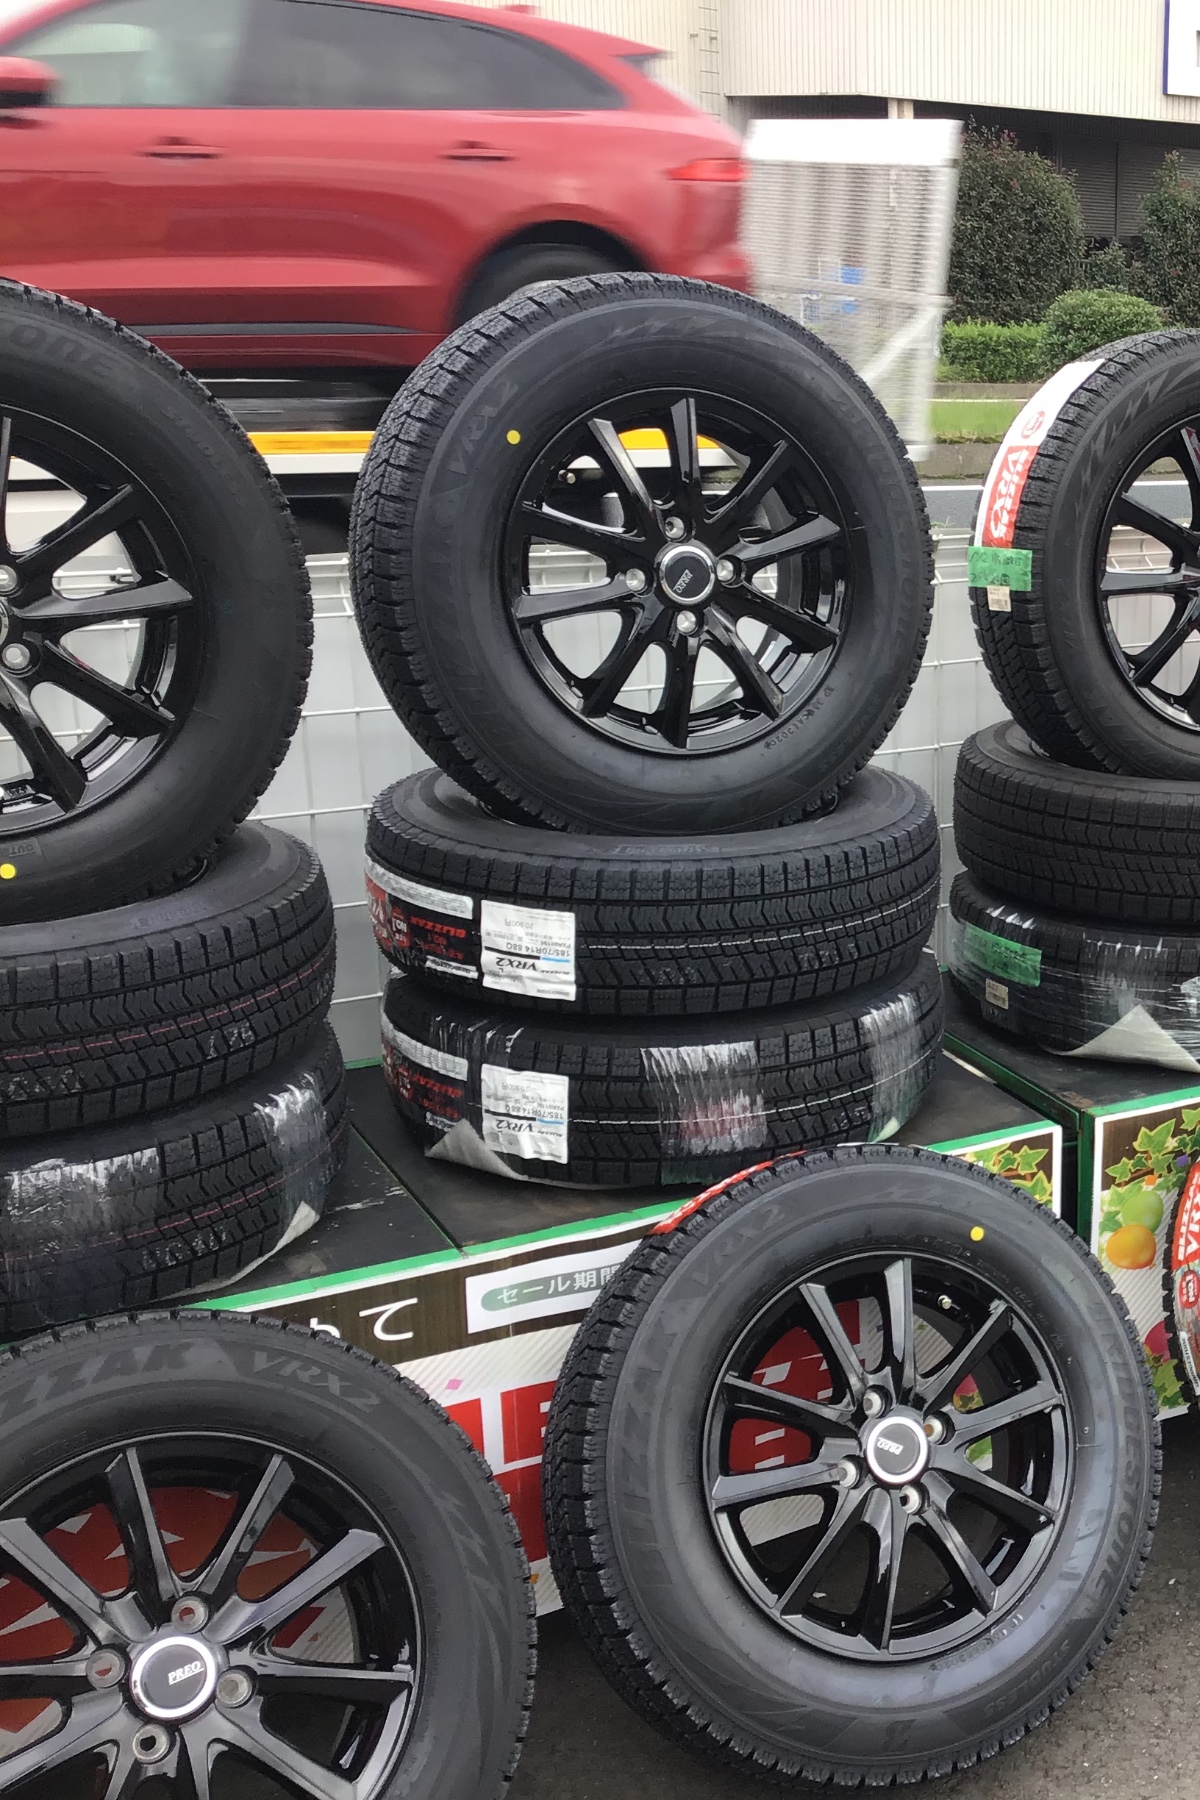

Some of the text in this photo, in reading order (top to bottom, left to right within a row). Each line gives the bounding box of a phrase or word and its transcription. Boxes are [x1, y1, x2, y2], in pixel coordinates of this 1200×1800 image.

[506, 942, 571, 957] 185/70R14 88Q
[495, 957, 537, 971] VRX2
[505, 1104, 564, 1119] 185/70R14 88Q
[495, 1119, 534, 1133] VRX2
[1177, 1170, 1199, 1262] BLIZZAK
[684, 1200, 788, 1292] VRX2
[250, 1349, 382, 1414] VRX2
[1087, 1300, 1143, 1601] BRIDGESTONE
[167, 1661, 203, 1684] PREO
